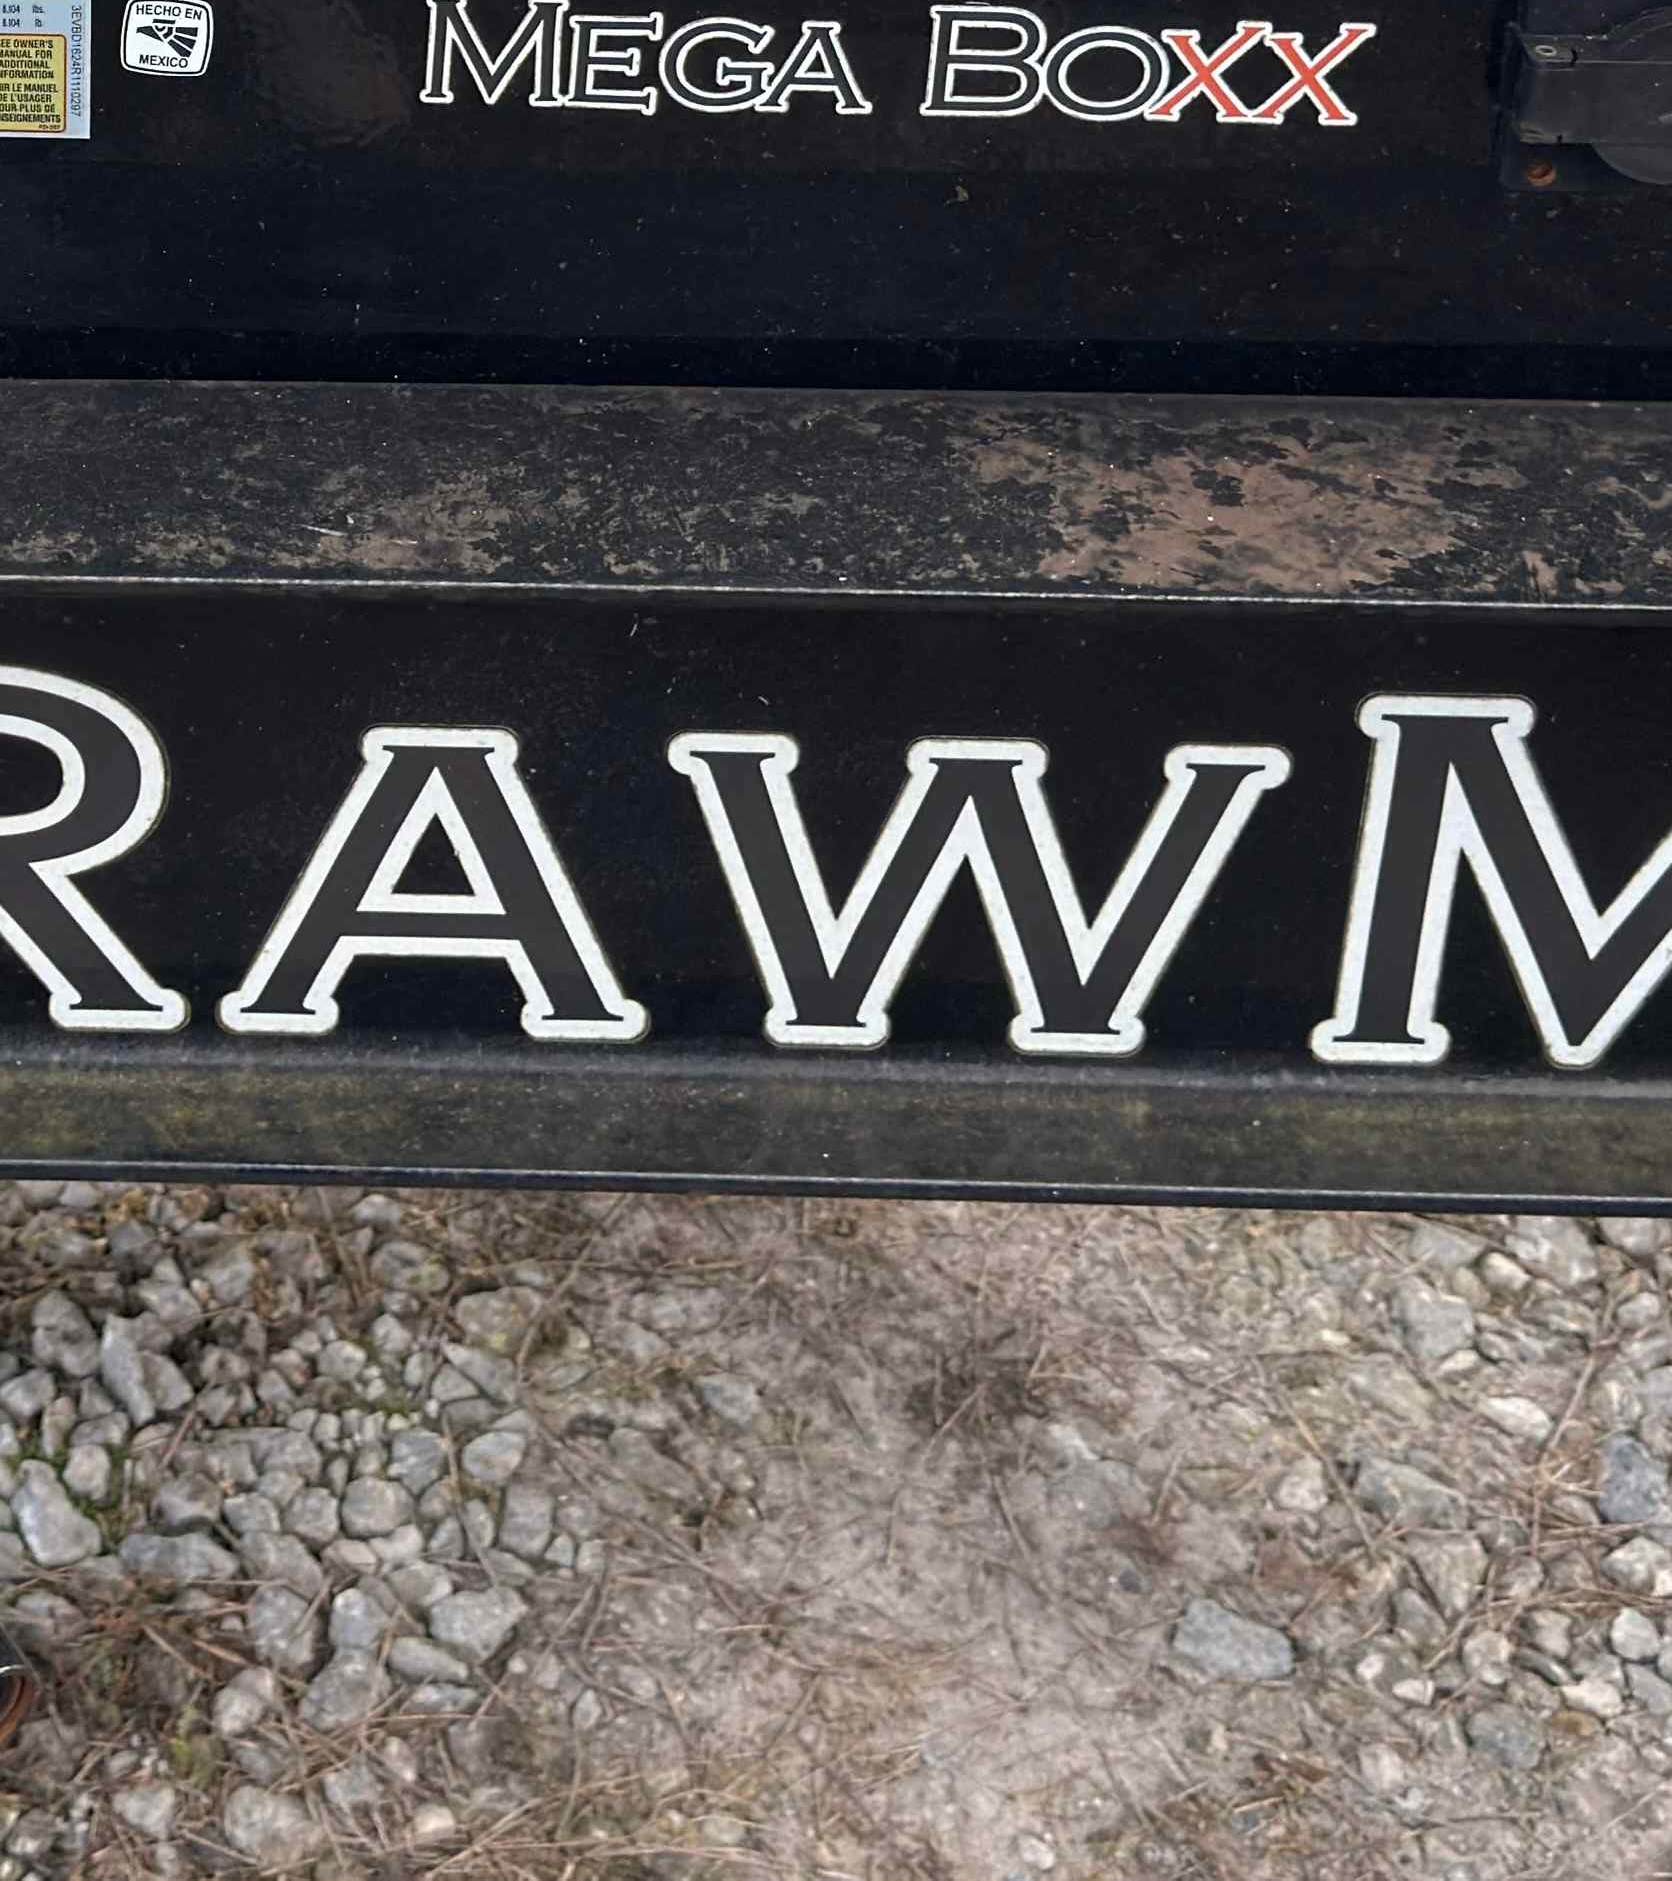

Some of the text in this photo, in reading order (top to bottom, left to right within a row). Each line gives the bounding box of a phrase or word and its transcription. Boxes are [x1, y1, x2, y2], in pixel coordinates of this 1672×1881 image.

[136, 4, 203, 21] HECHO EN
[13, 39, 53, 48] OWNER'S
[35, 50, 53, 59] FOR
[139, 54, 189, 68] MEXICO
[919, 4, 1377, 126] BOXX
[12, 83, 22, 92] LE
[24, 83, 58, 93] MANUEL
[10, 93, 52, 103] L'USAGER
[19, 103, 42, 113] PLUS
[44, 104, 55, 113] DE
